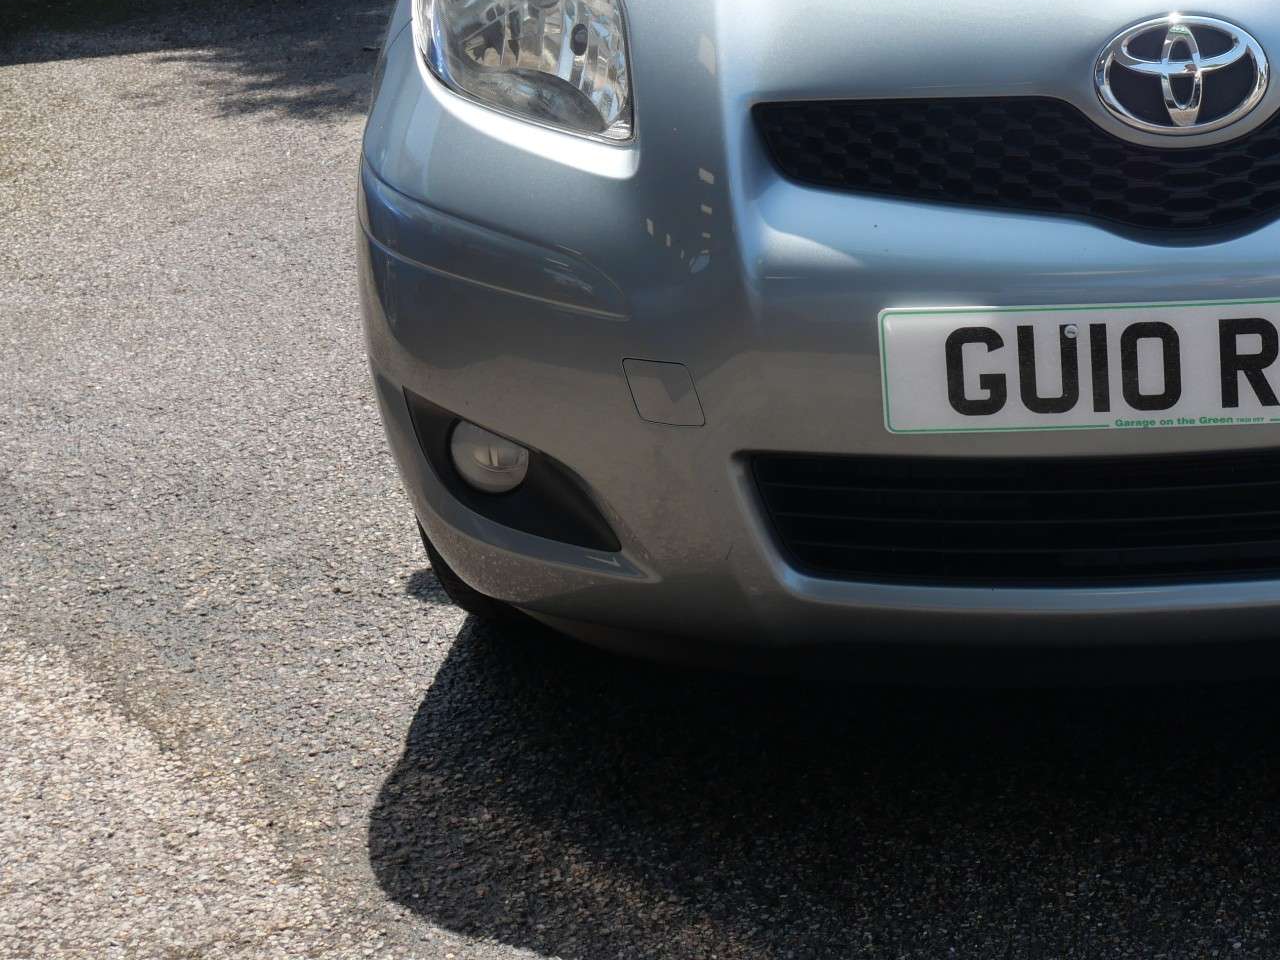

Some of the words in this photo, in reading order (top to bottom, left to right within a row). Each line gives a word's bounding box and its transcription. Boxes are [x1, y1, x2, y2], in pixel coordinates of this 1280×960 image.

[1115, 418, 1156, 428] Garage
[1177, 417, 1195, 425] the
[1199, 415, 1234, 425] Green
